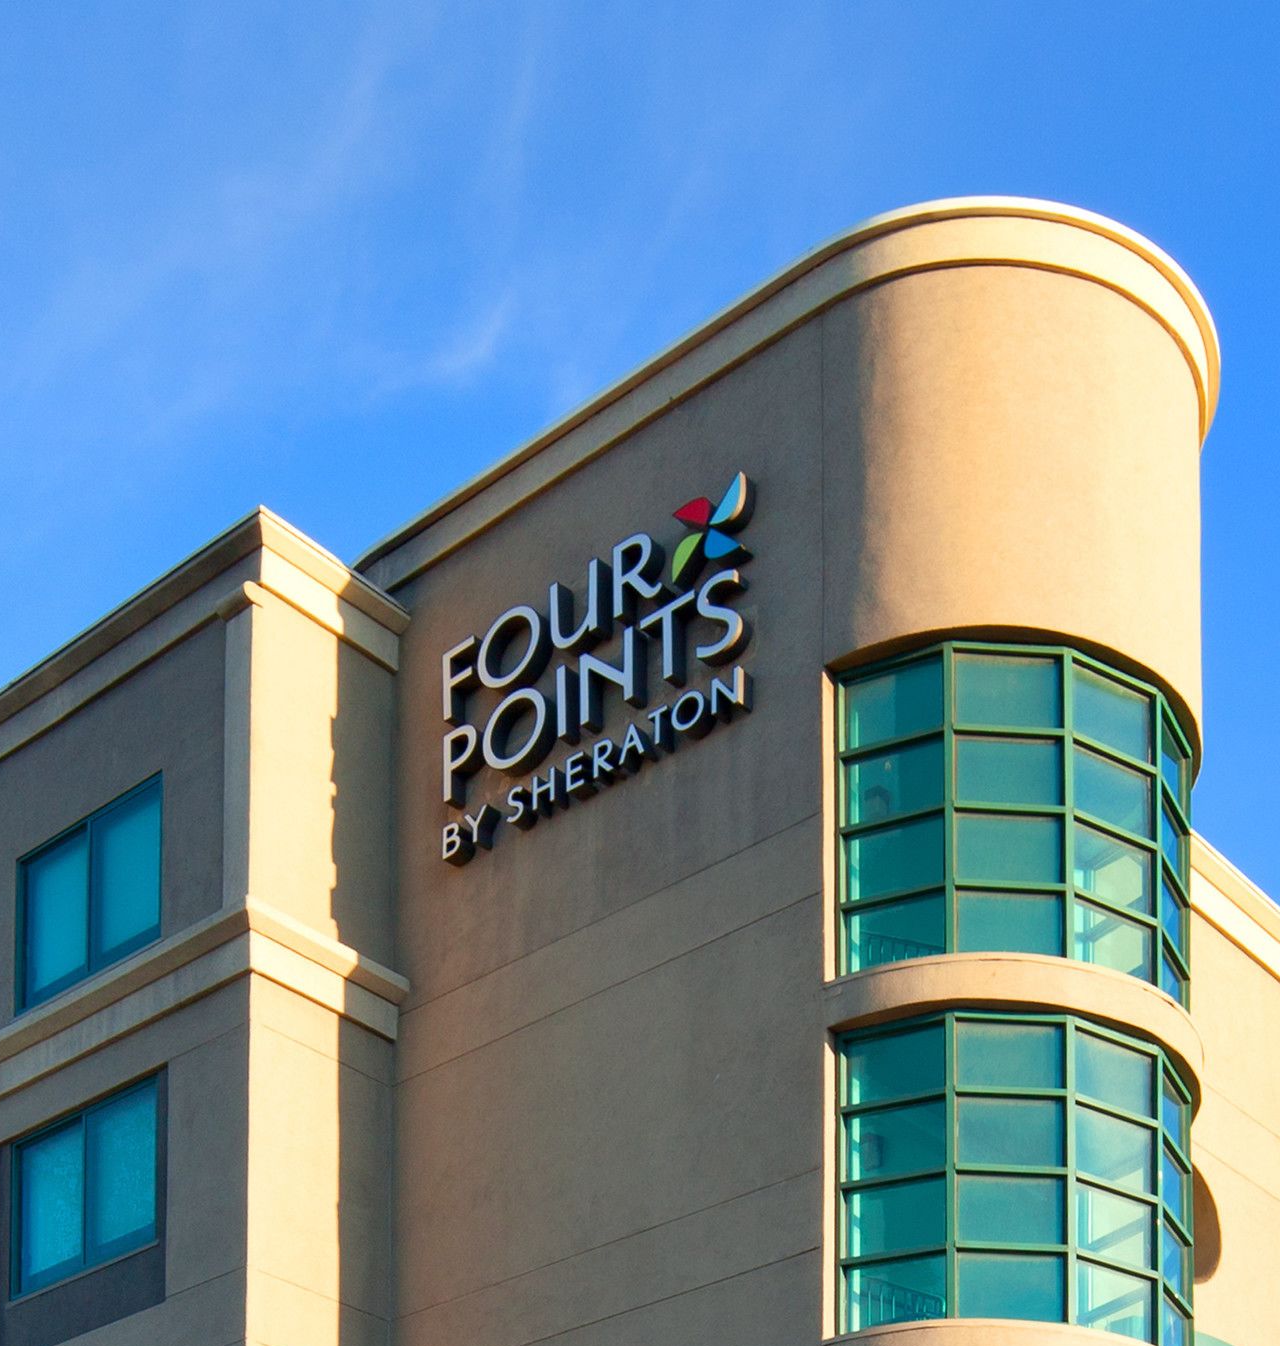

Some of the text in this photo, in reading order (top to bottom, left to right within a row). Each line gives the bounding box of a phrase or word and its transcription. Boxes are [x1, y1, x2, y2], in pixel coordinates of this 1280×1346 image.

[441, 532, 663, 723] FOUR
[442, 568, 746, 805] POINTS
[441, 665, 746, 861] BY SHERATON
